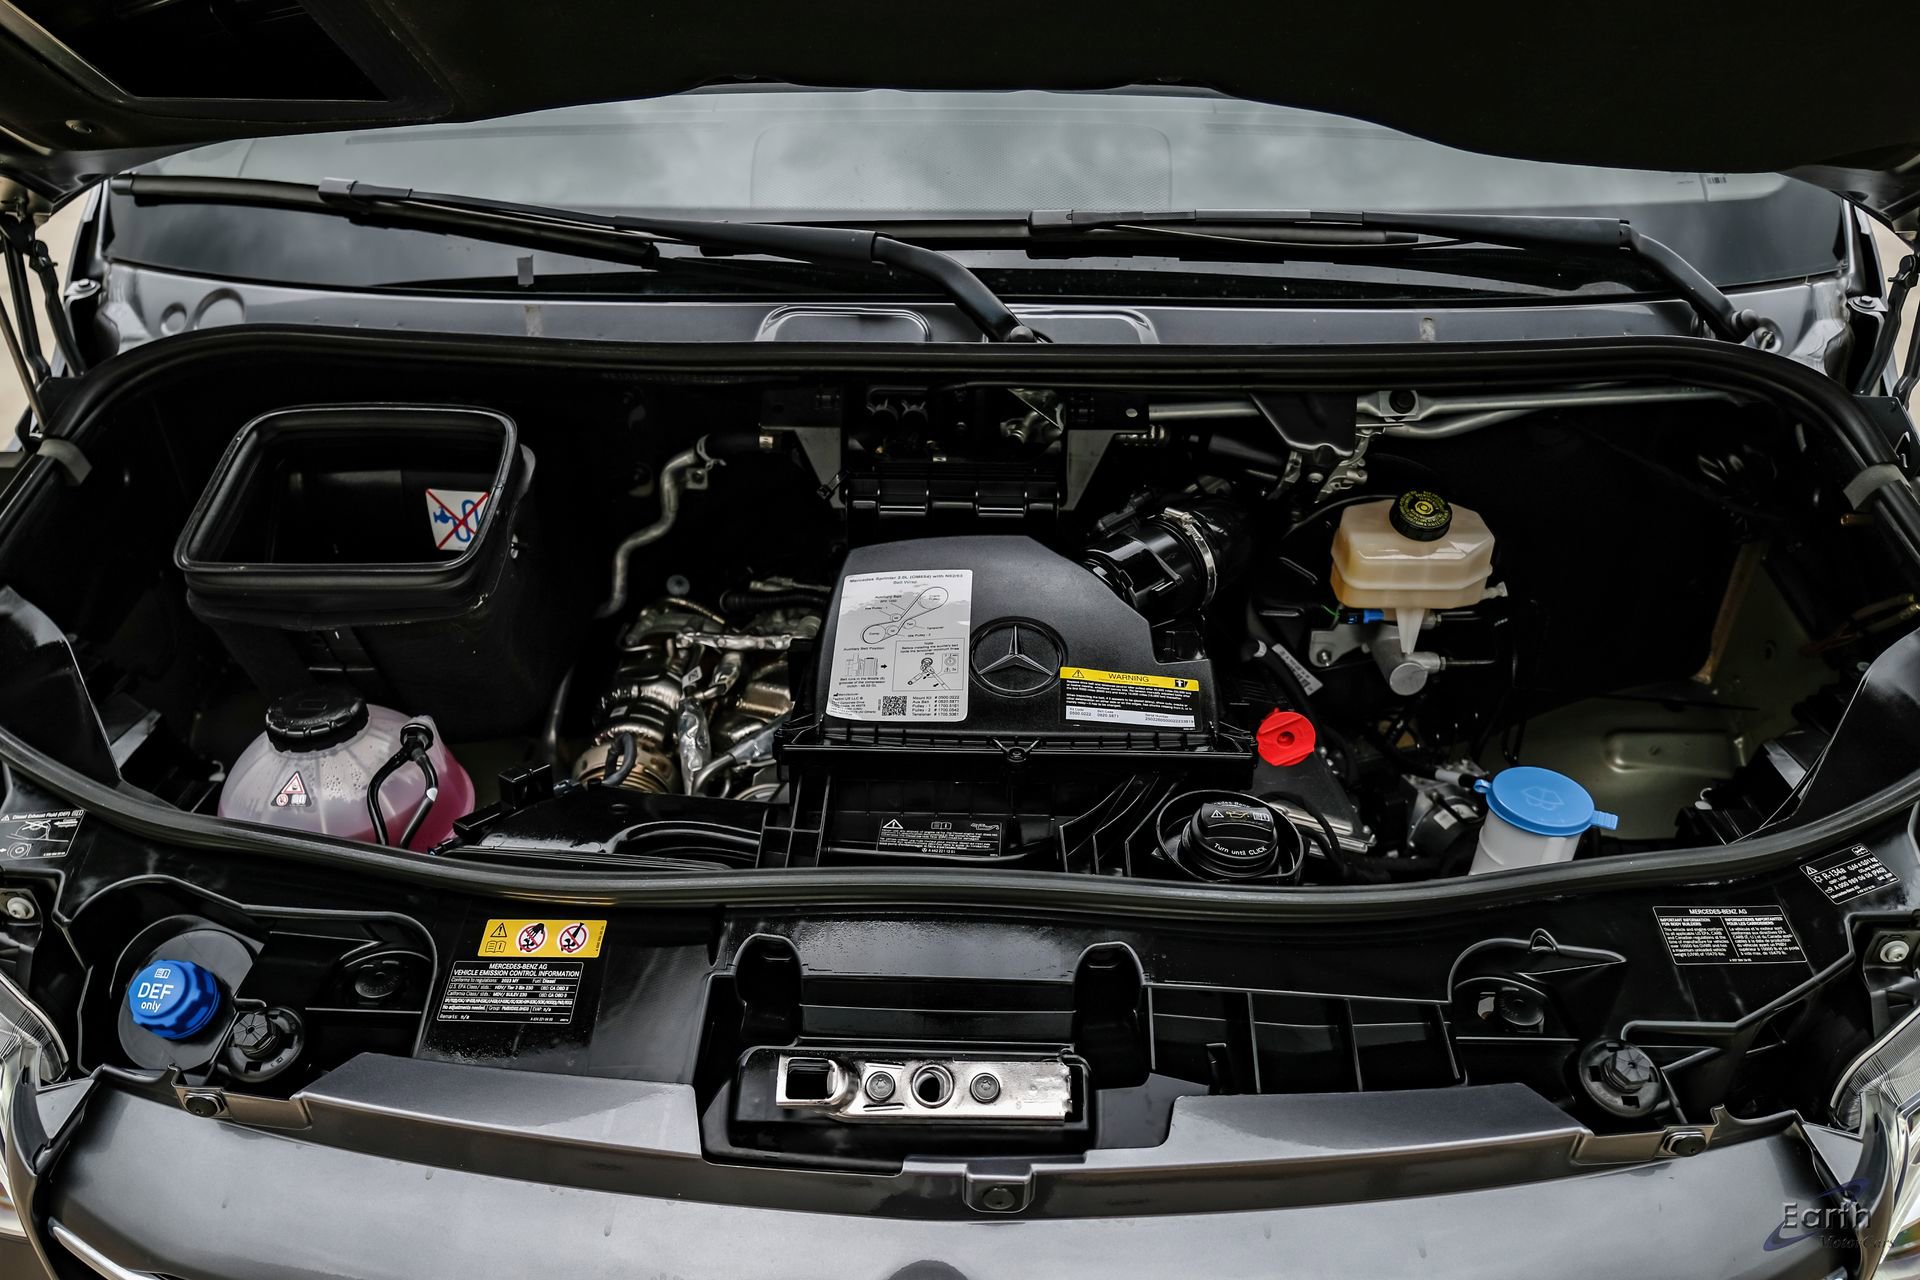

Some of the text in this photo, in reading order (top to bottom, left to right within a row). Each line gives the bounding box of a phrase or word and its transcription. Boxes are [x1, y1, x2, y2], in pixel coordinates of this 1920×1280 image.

[1108, 673, 1150, 683] WARNING
[1214, 843, 1229, 854] Turn
[1248, 846, 1268, 856] CLICK
[1821, 868, 1847, 880] R-134a
[138, 982, 175, 1000] DEF
[141, 1001, 161, 1013] only
